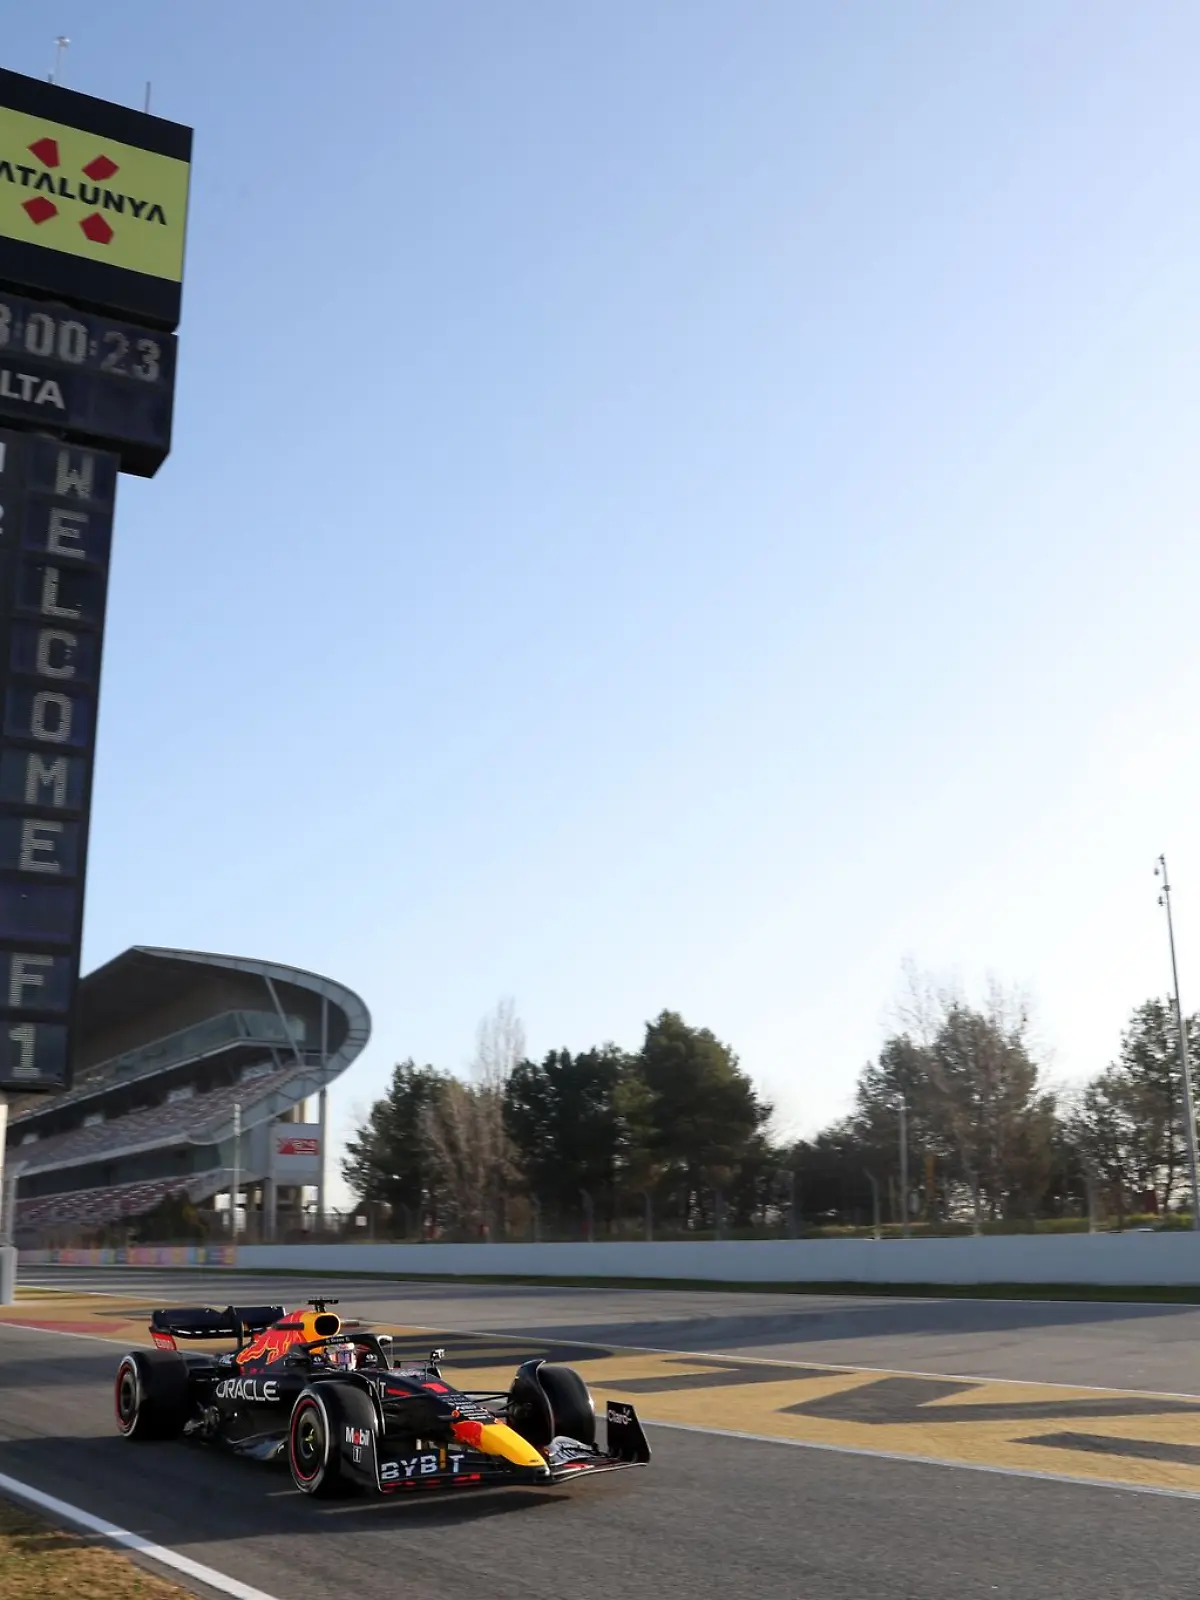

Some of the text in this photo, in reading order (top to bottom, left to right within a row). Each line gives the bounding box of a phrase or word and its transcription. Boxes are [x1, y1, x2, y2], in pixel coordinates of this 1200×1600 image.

[0, 370, 66, 410] LTA
[18, 450, 93, 875] WELCOME
[216, 1379, 280, 1401] ORACLE
[346, 1427, 370, 1447] Mobil
[381, 1448, 464, 1480] BYBIT
